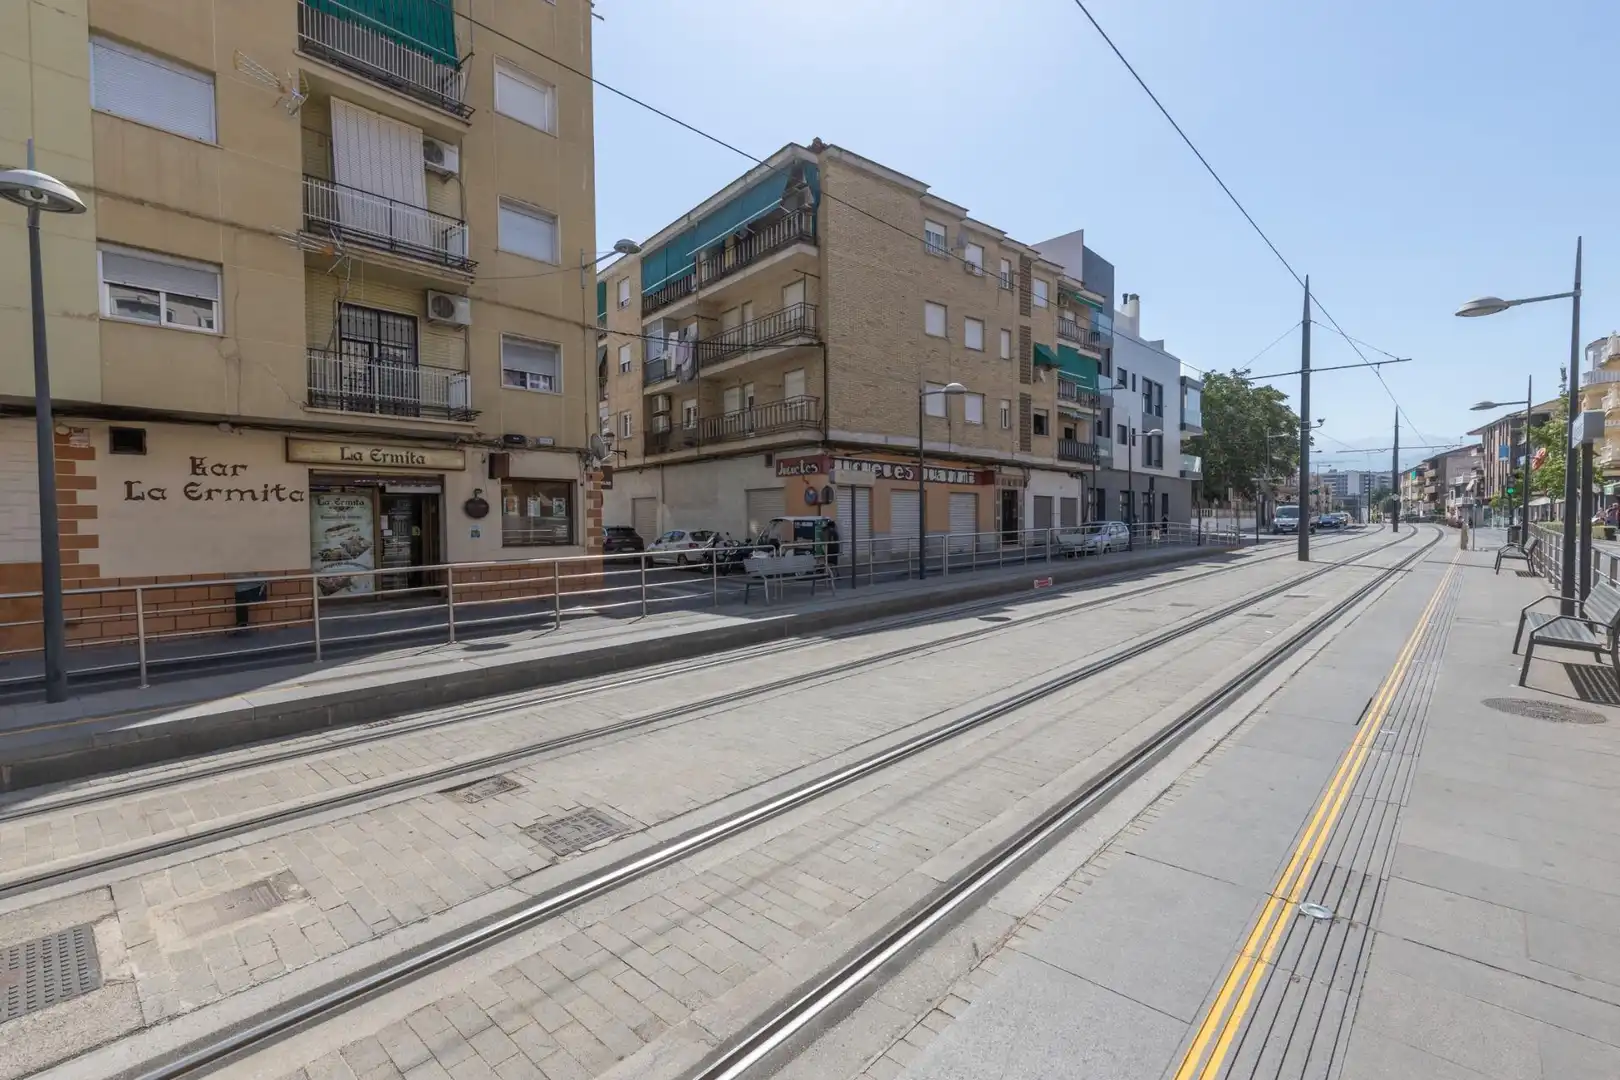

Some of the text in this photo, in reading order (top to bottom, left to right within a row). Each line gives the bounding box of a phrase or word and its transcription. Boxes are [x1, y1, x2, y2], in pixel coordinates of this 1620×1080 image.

[340, 446, 426, 465] La Ermita
[189, 456, 248, 477] Bar
[124, 480, 305, 503] La Ermita
